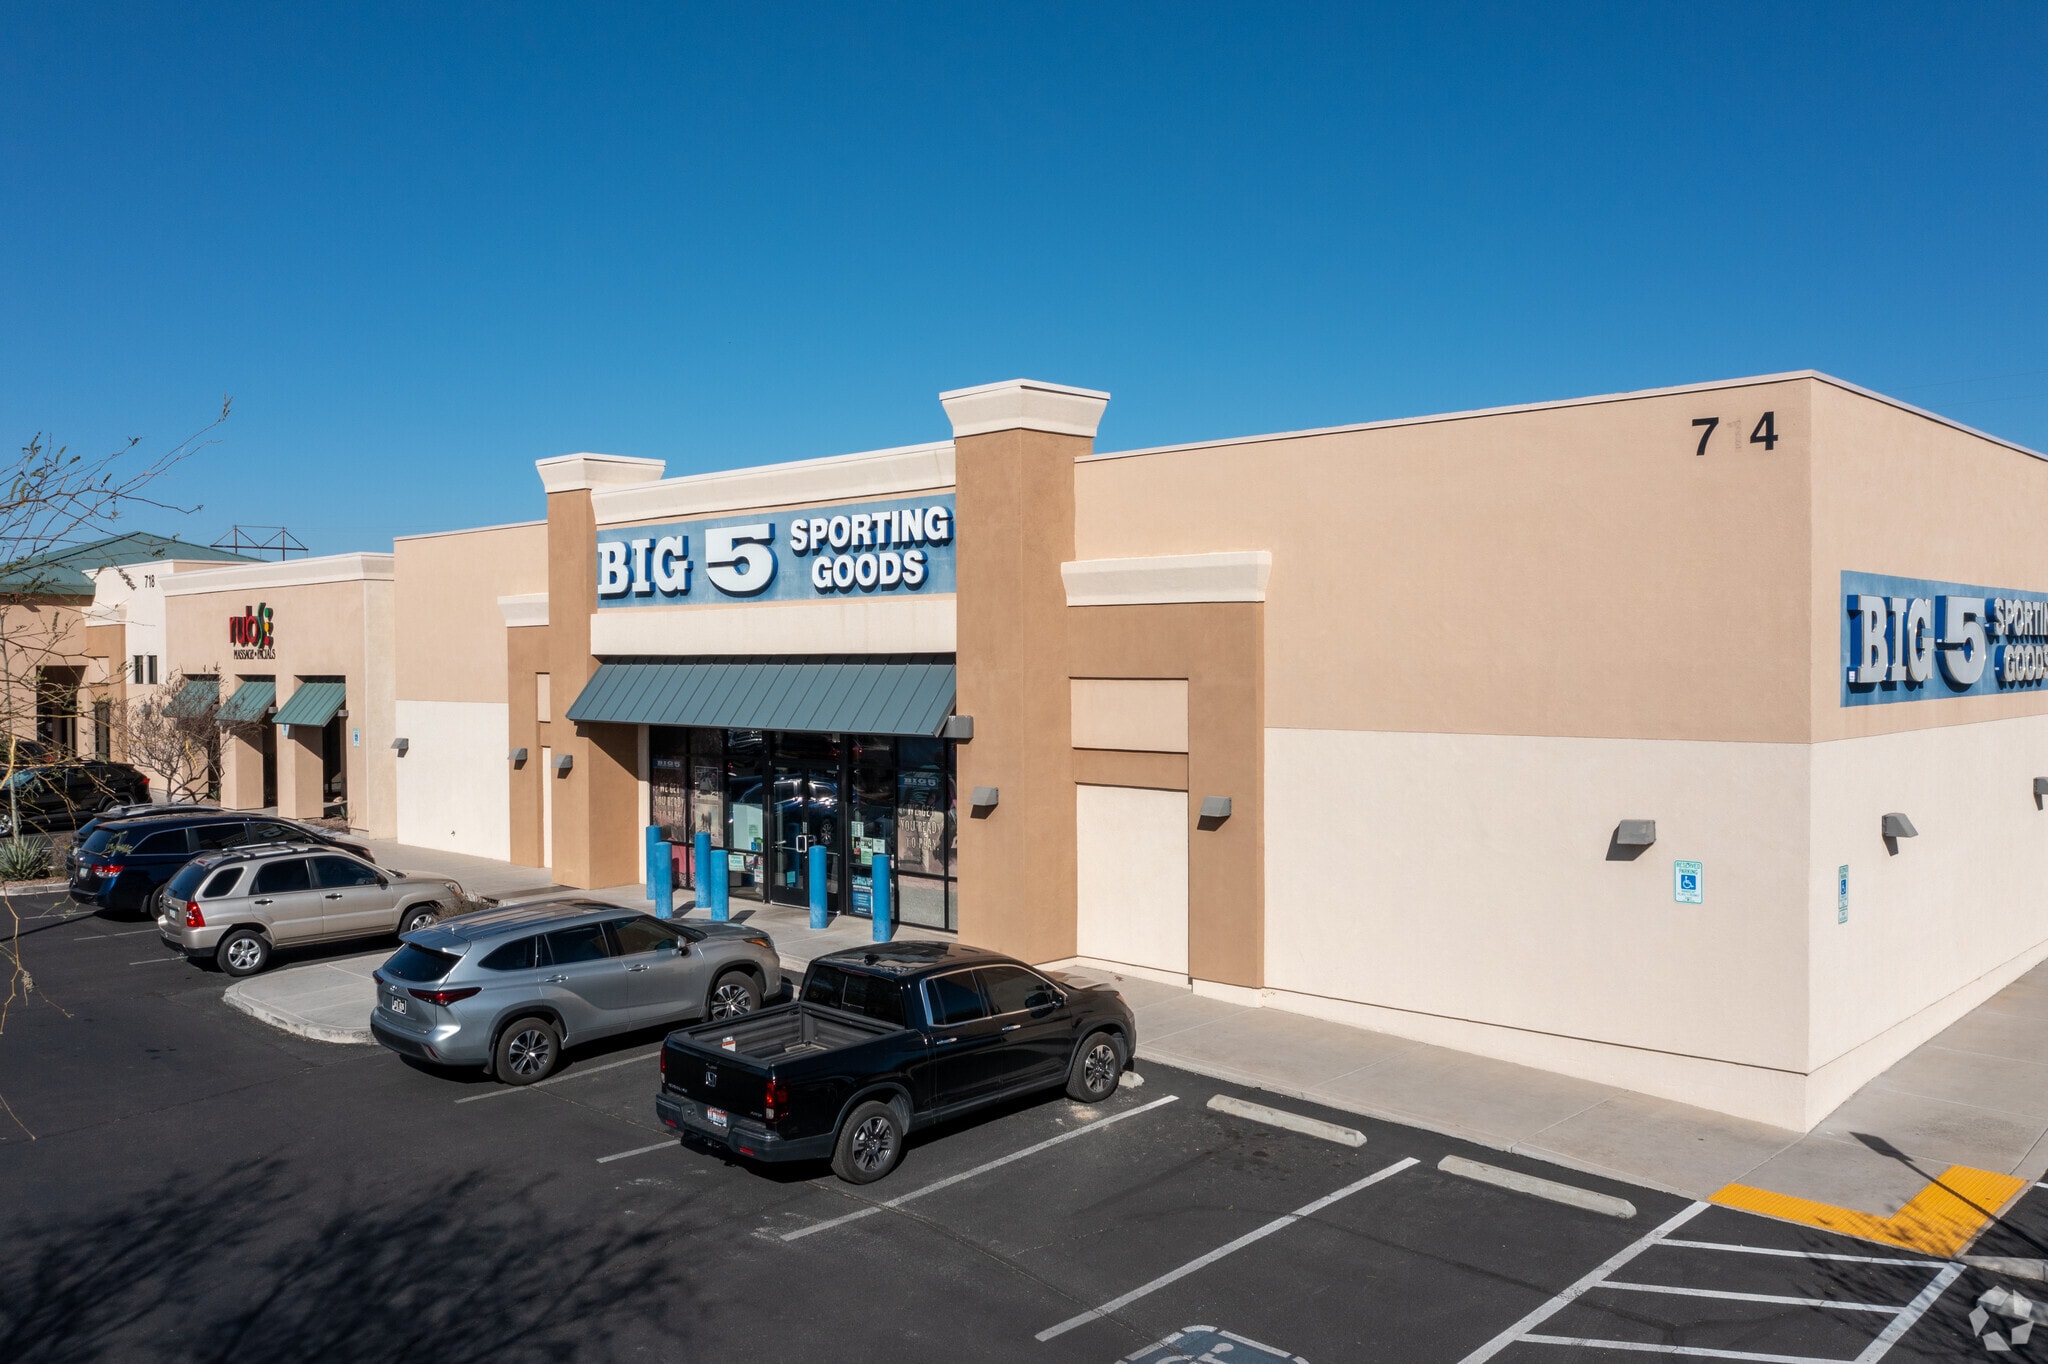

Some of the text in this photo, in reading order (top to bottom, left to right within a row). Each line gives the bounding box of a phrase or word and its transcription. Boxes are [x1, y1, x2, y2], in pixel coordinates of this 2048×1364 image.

[790, 506, 952, 553] SPORTING
[598, 523, 776, 596] BIG 5
[812, 550, 926, 591] GOODS
[144, 574, 156, 588] 718
[1850, 594, 1987, 685] BIG 5
[233, 649, 255, 660] MASSAGE
[907, 803, 935, 818] WE GET
[900, 819, 943, 834] YOU READY
[905, 836, 916, 849] TO
